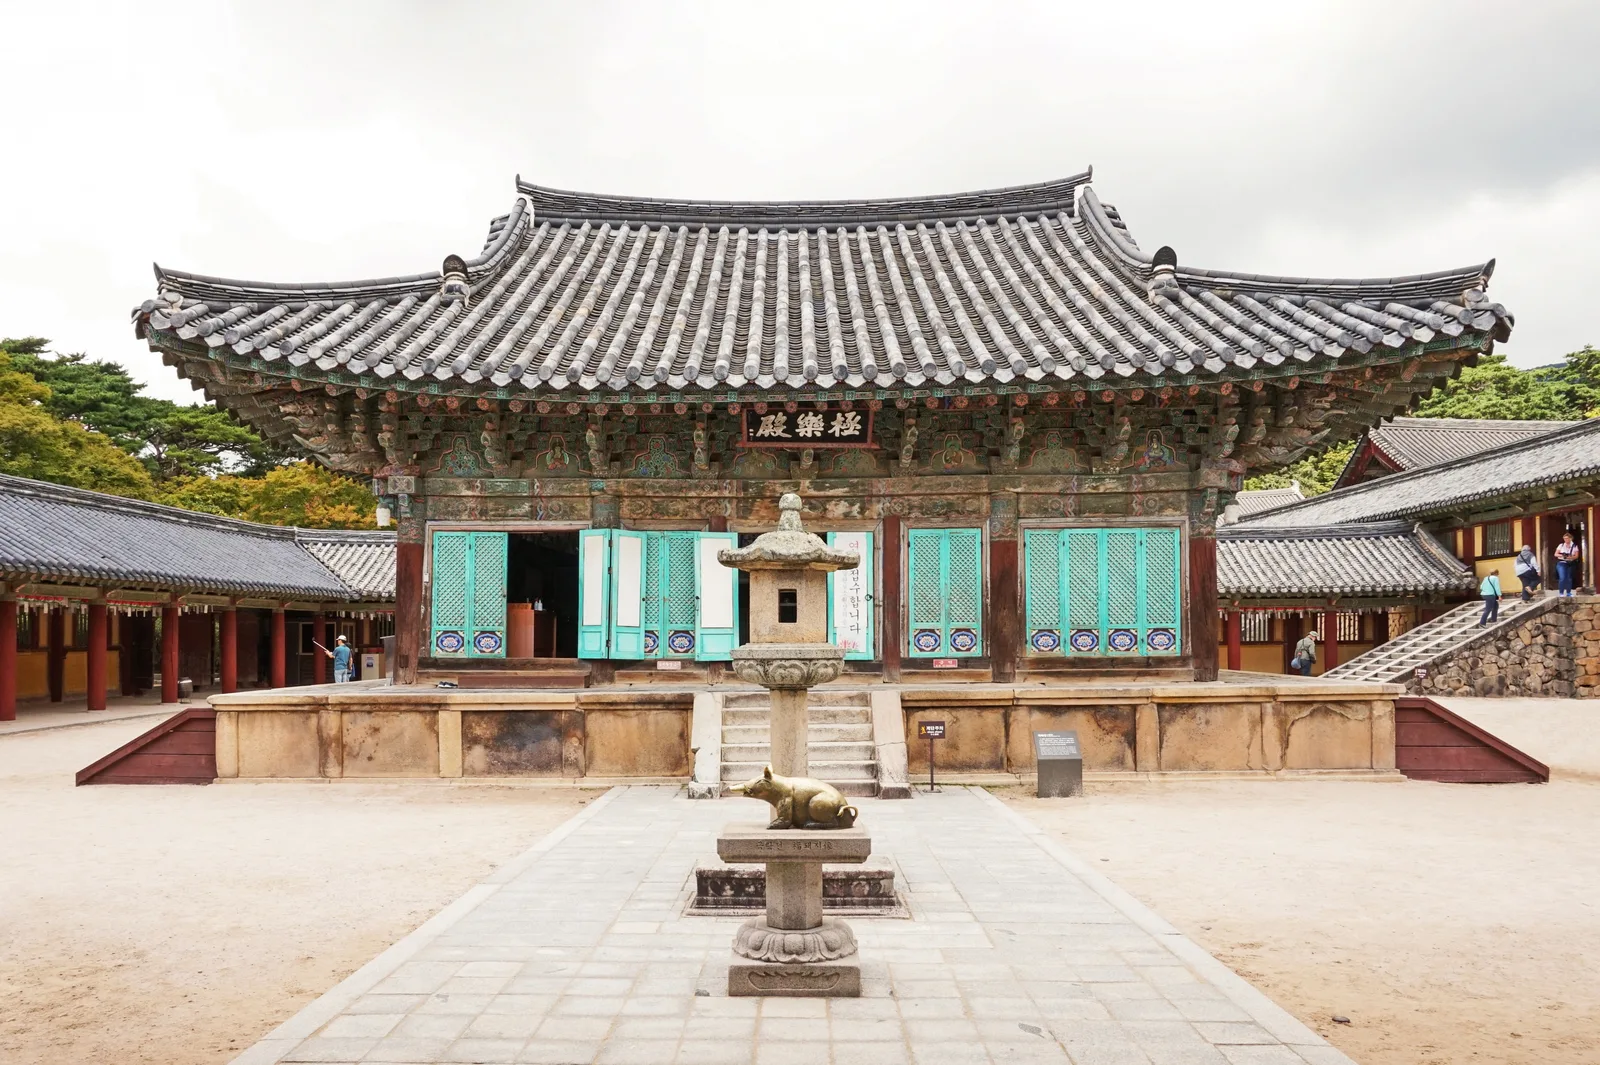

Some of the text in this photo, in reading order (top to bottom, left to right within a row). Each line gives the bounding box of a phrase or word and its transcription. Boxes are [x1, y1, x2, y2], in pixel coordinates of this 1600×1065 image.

[756, 412, 861, 438] 極樂殿
[849, 569, 860, 634] 접수합니다
